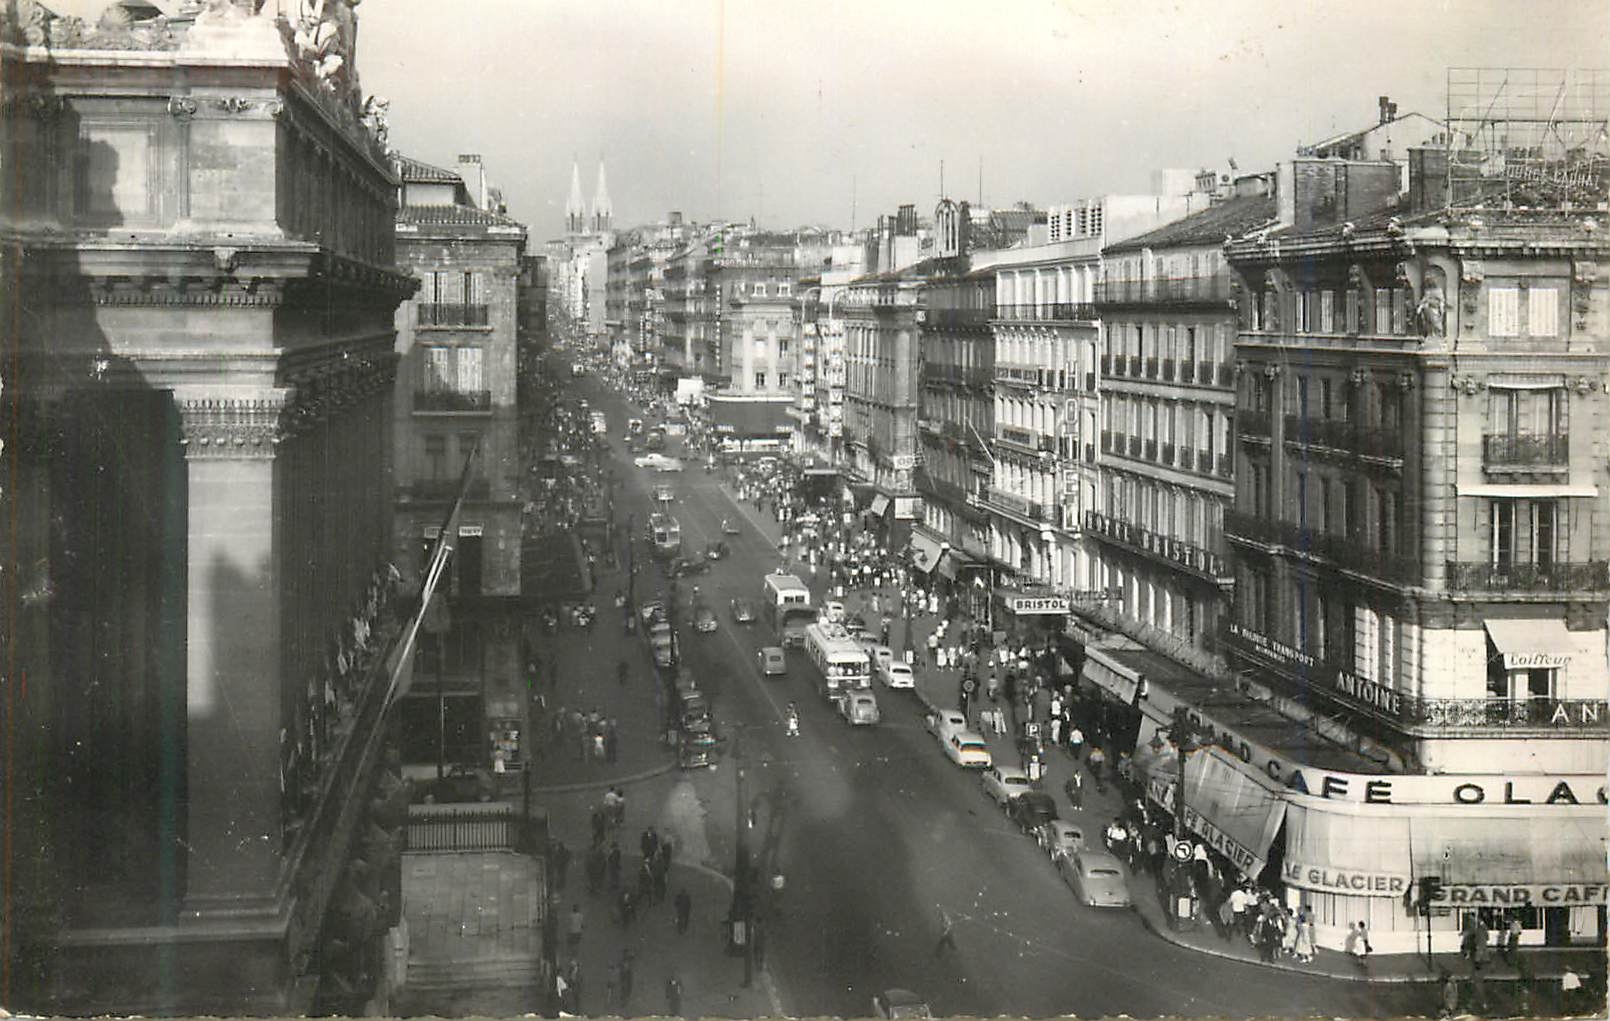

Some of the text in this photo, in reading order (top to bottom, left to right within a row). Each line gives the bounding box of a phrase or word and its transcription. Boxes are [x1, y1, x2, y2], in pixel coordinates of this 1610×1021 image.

[1064, 361, 1078, 531] HOTEL
[1016, 600, 1066, 609] BRISTOL
[1336, 670, 1400, 715] ANTOINE
[1308, 869, 1404, 892] GLACIER
[1542, 886, 1608, 903] CAF
